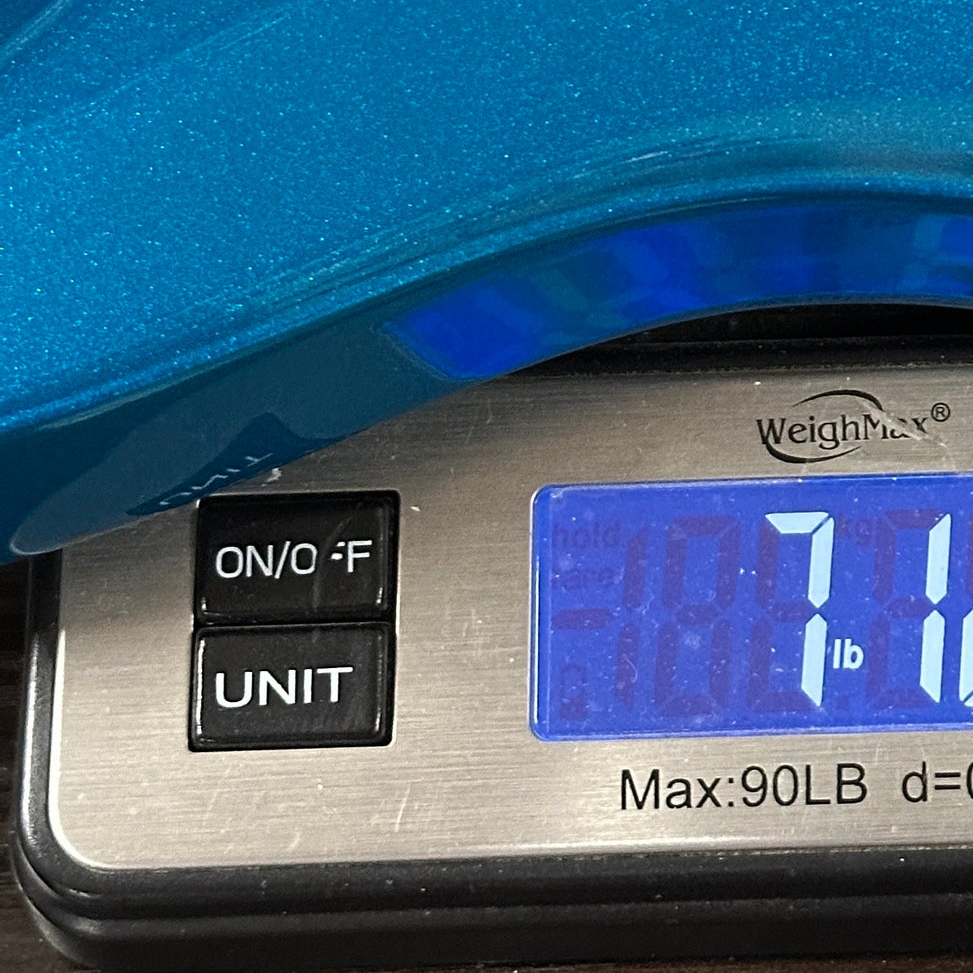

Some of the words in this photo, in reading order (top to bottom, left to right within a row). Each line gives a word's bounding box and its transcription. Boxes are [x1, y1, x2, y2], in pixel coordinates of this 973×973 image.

[765, 511, 835, 707] 7
[832, 638, 864, 669] lb
[215, 666, 354, 708] UNIT
[620, 761, 868, 810] Max:90LB
